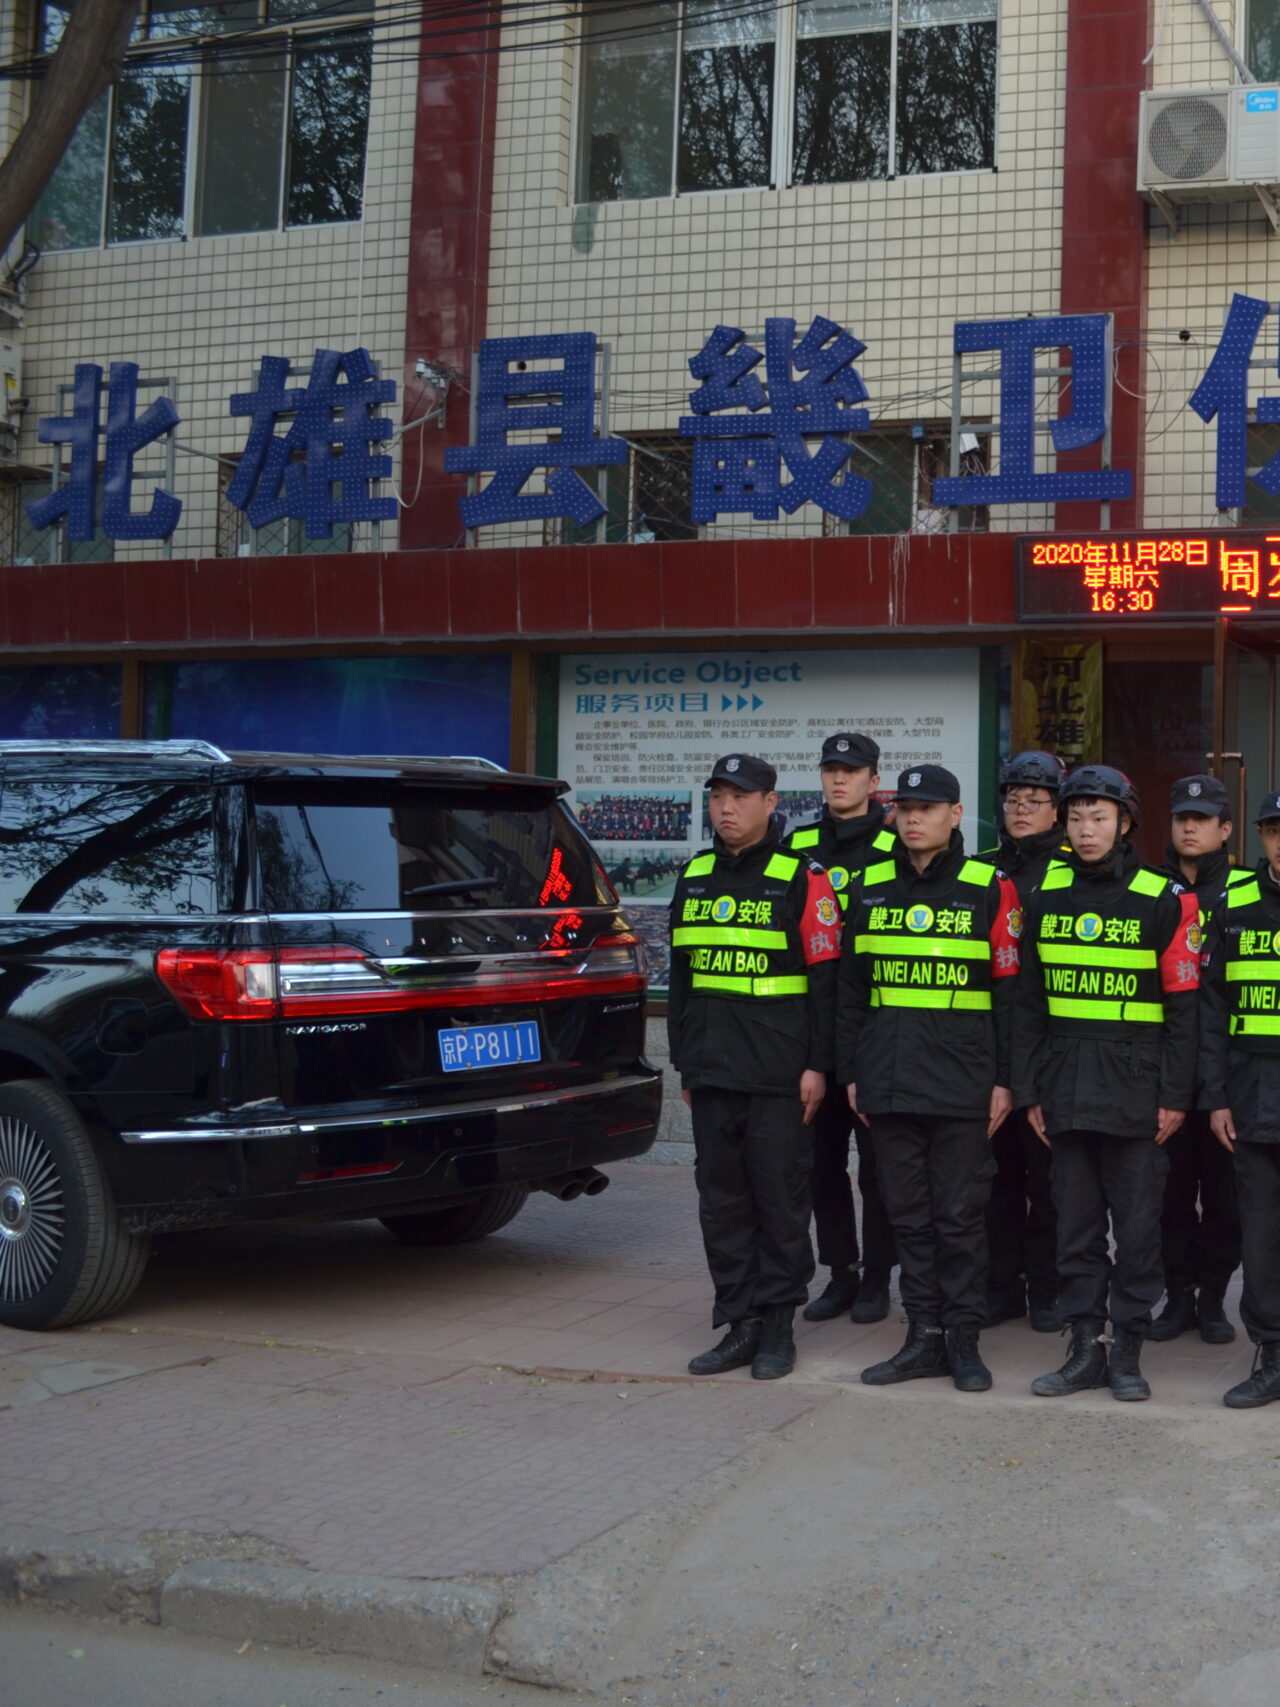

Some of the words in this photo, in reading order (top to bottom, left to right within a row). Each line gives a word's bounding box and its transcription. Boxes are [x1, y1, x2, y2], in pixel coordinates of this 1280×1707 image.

[1032, 541, 1208, 566] 2020年11月28日
[1083, 565, 1160, 589] 星期六
[1092, 591, 1154, 613] 16:30
[575, 662, 685, 686] Service
[696, 659, 803, 690] Object
[575, 693, 709, 714] 服务项目
[682, 898, 713, 922] 畿卫
[737, 900, 773, 925] 安保
[868, 907, 904, 930] 畿卫
[936, 909, 973, 934] 安保
[385, 931, 578, 947] LINCOLN
[1040, 914, 1073, 938] 畿卫
[1104, 918, 1141, 944] 安保
[1239, 930, 1271, 955] 畿卫
[711, 950, 733, 972] AN
[735, 951, 769, 974] BAO
[883, 961, 908, 983] WEI
[910, 962, 932, 984] AN
[936, 963, 969, 986] BAO
[1052, 969, 1076, 992] WEI
[1078, 971, 1100, 995] AN
[1104, 973, 1137, 996] BAO
[1239, 986, 1248, 1008] JI
[1250, 986, 1276, 1010] WEI
[285, 1022, 368, 1035] NAVIGATOR
